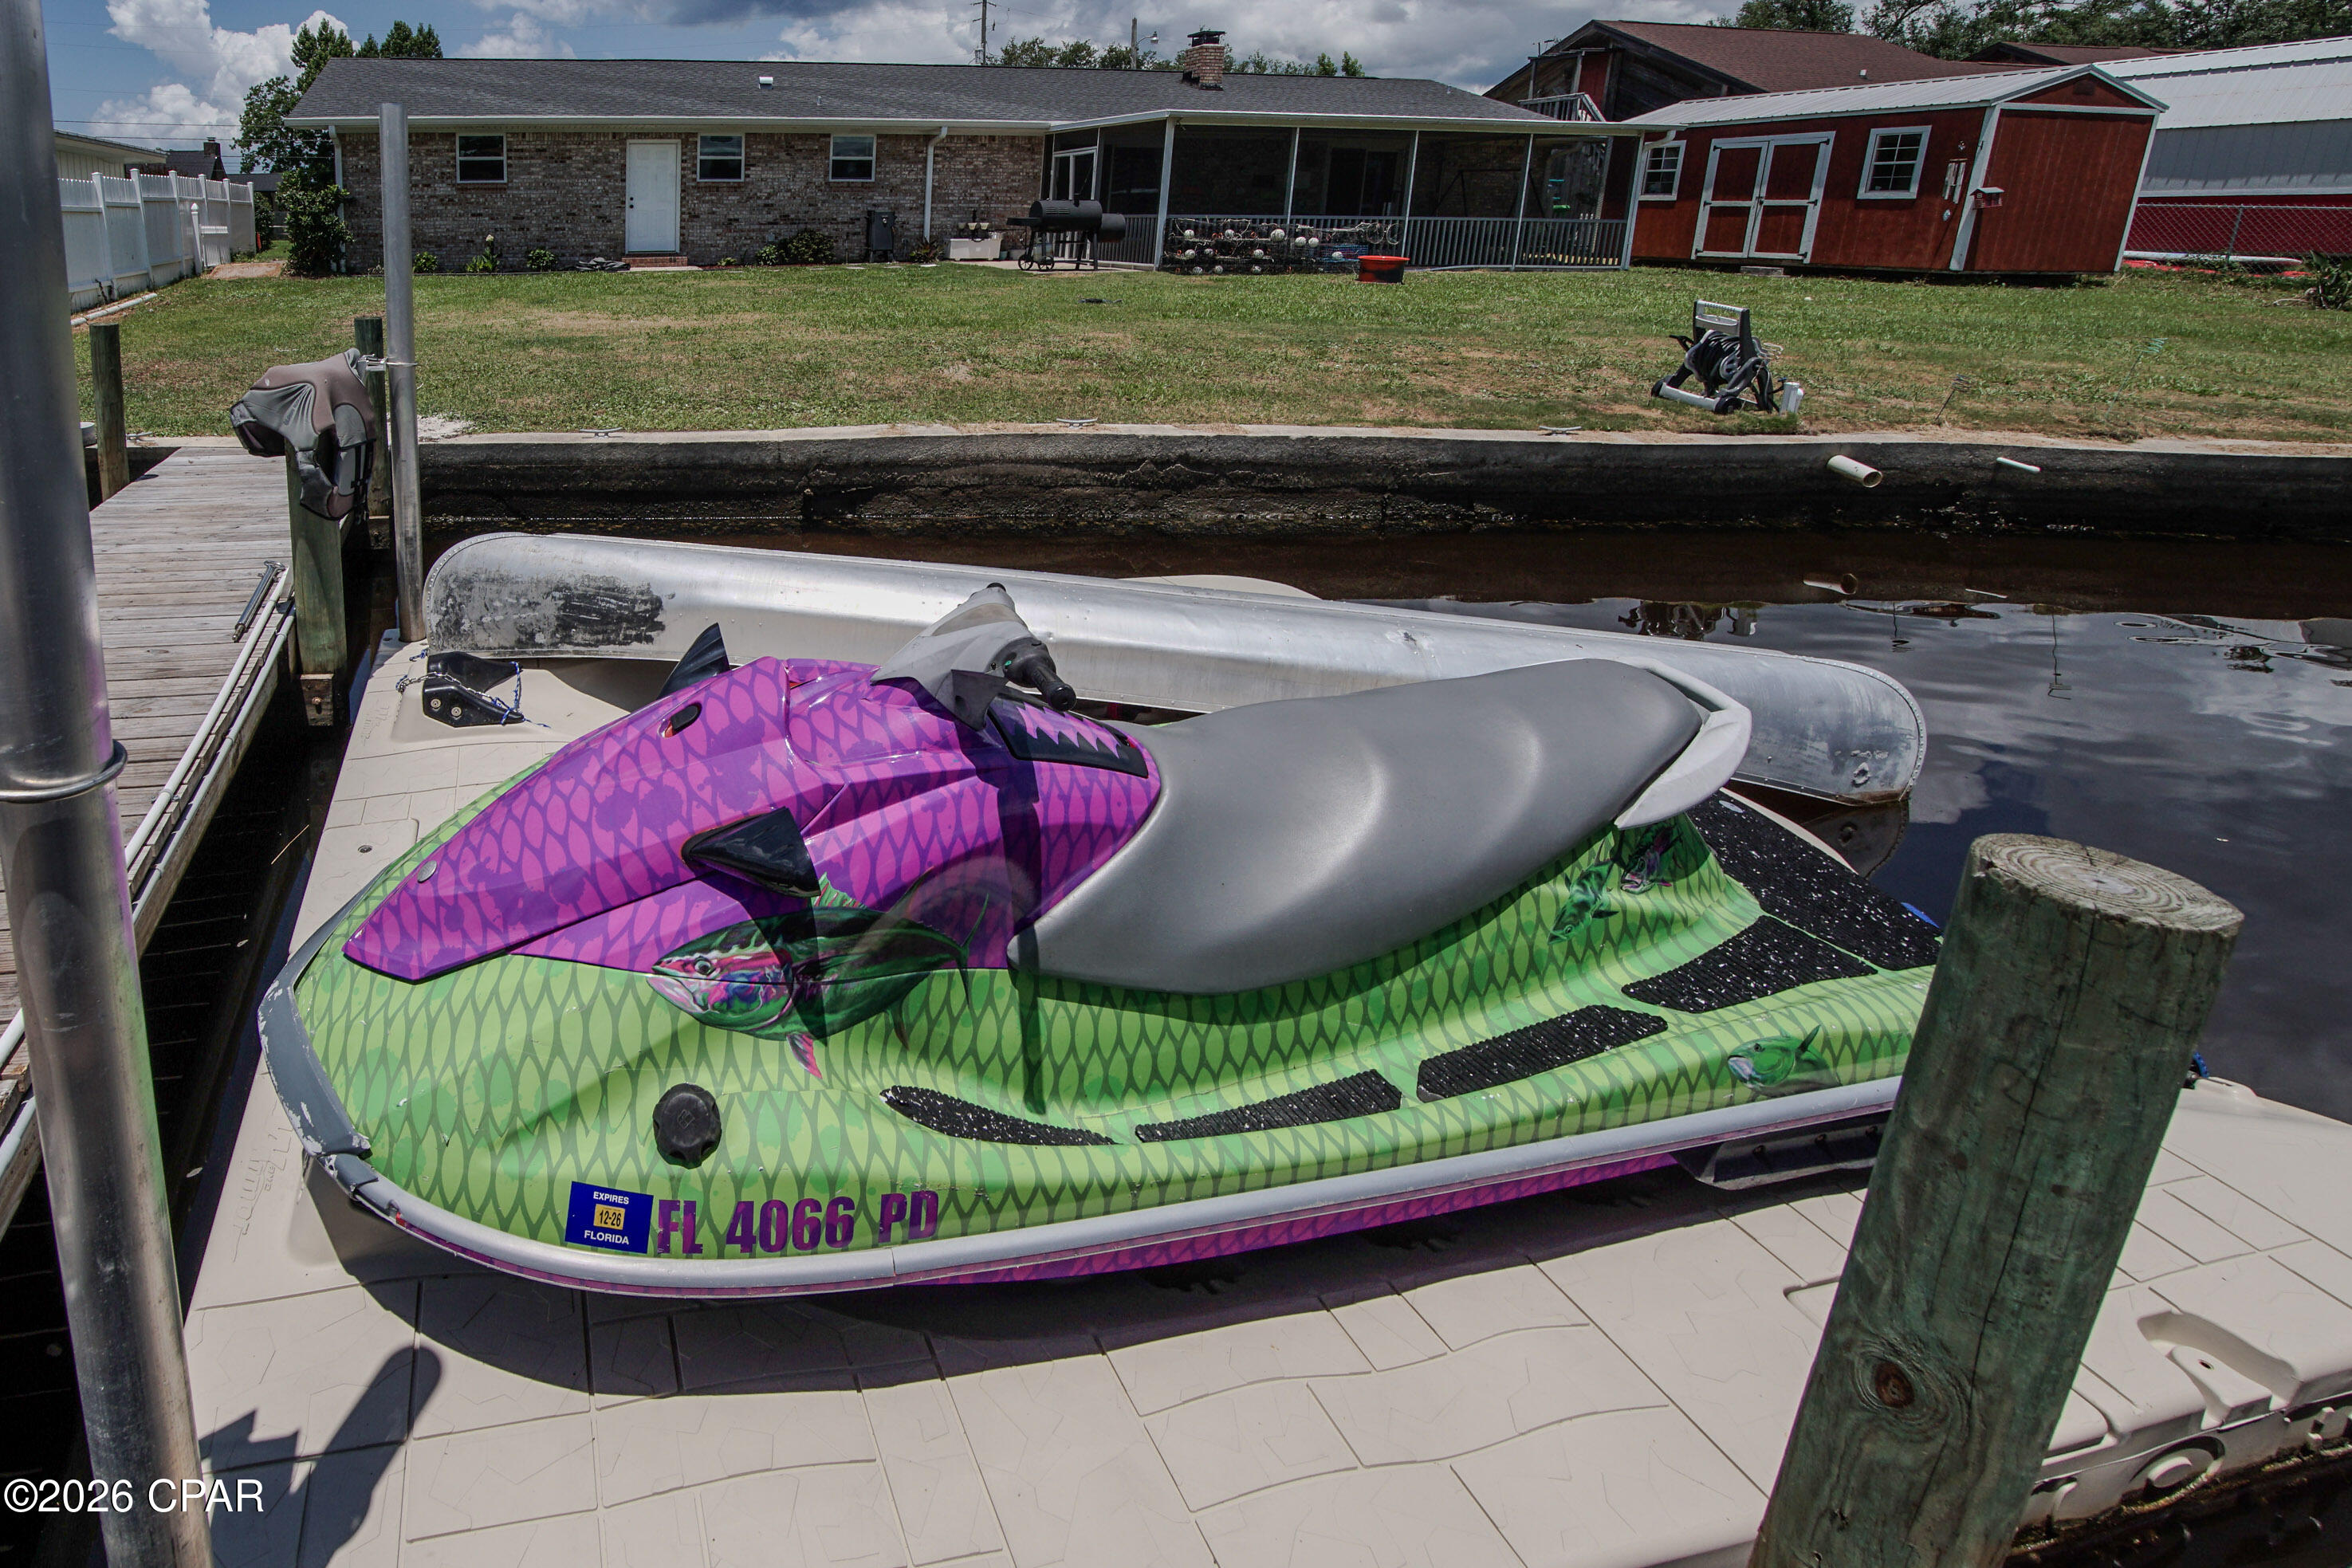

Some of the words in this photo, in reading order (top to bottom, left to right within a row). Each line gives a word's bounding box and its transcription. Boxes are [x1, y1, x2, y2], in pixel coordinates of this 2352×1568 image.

[593, 1191, 629, 1204] EXPIRES
[600, 1210, 621, 1227] 12-26
[658, 1200, 702, 1253] FL
[726, 1197, 855, 1253] 4066
[879, 1190, 939, 1244] PD
[584, 1230, 629, 1244] FLORIDA
